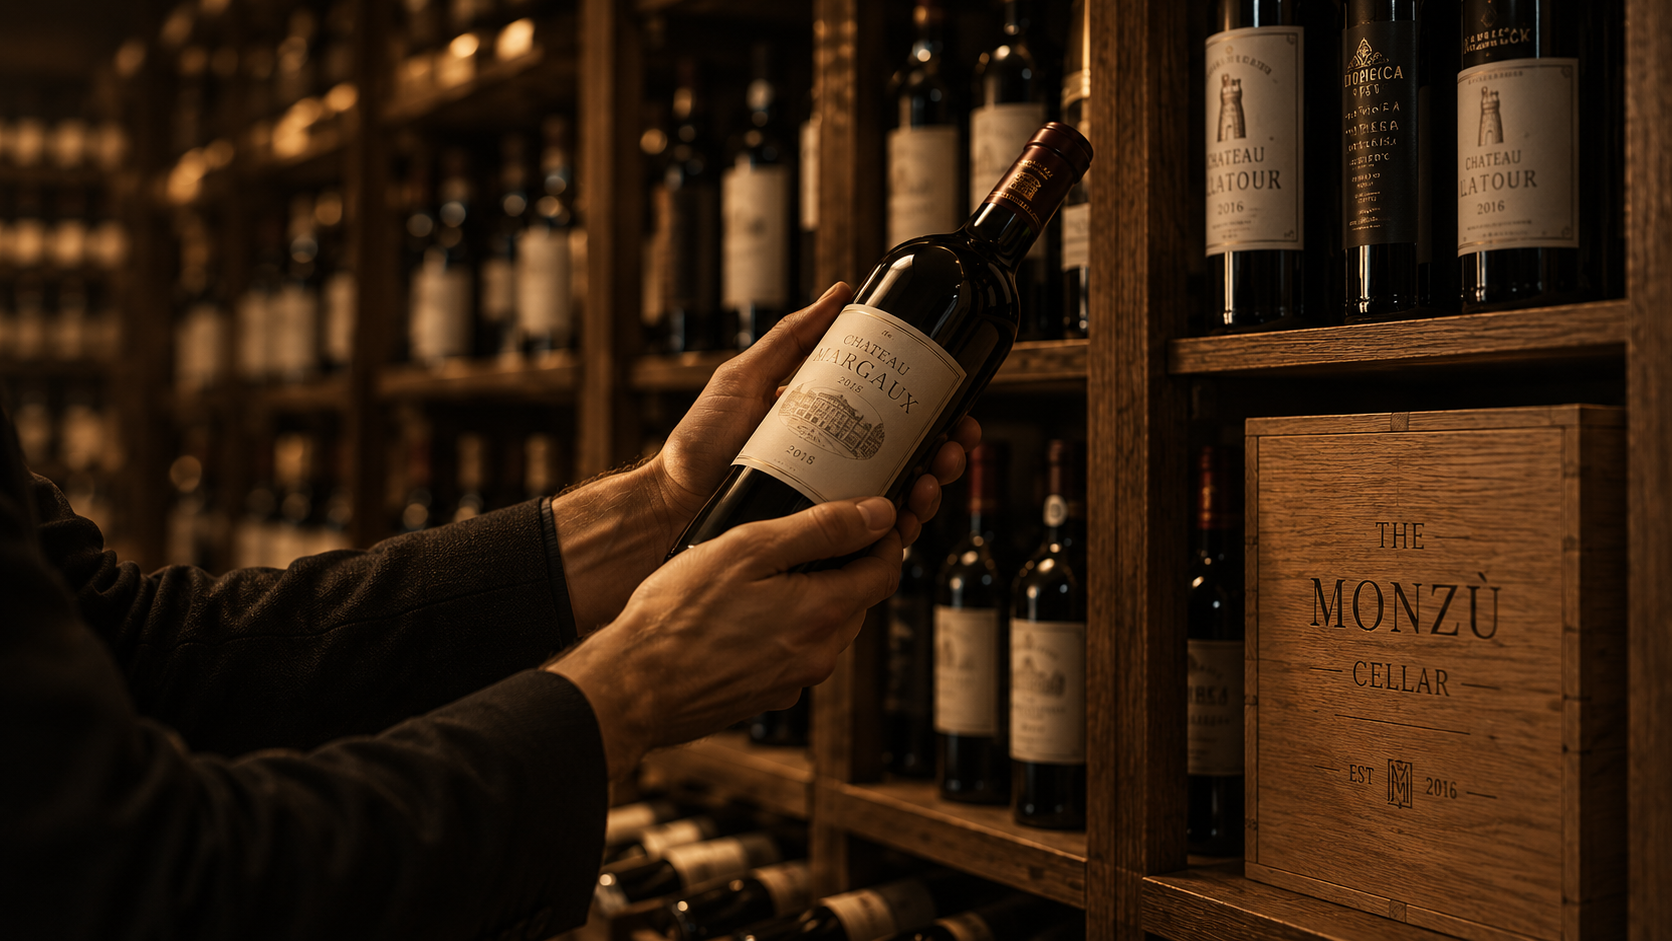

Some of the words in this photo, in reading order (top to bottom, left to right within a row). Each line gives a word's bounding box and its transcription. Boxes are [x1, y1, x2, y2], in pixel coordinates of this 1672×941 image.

[1465, 150, 1521, 170] CHATEAU
[1218, 201, 1244, 215] 2016
[1477, 200, 1505, 215] 2016
[843, 334, 910, 376] CHATEAU
[813, 347, 919, 414] MARGAUX
[1375, 521, 1425, 549] THE
[1309, 571, 1502, 640] MONZÙ
[1352, 660, 1450, 697] CELLAR
[1349, 764, 1374, 785] EST
[1426, 776, 1458, 800] 2016
